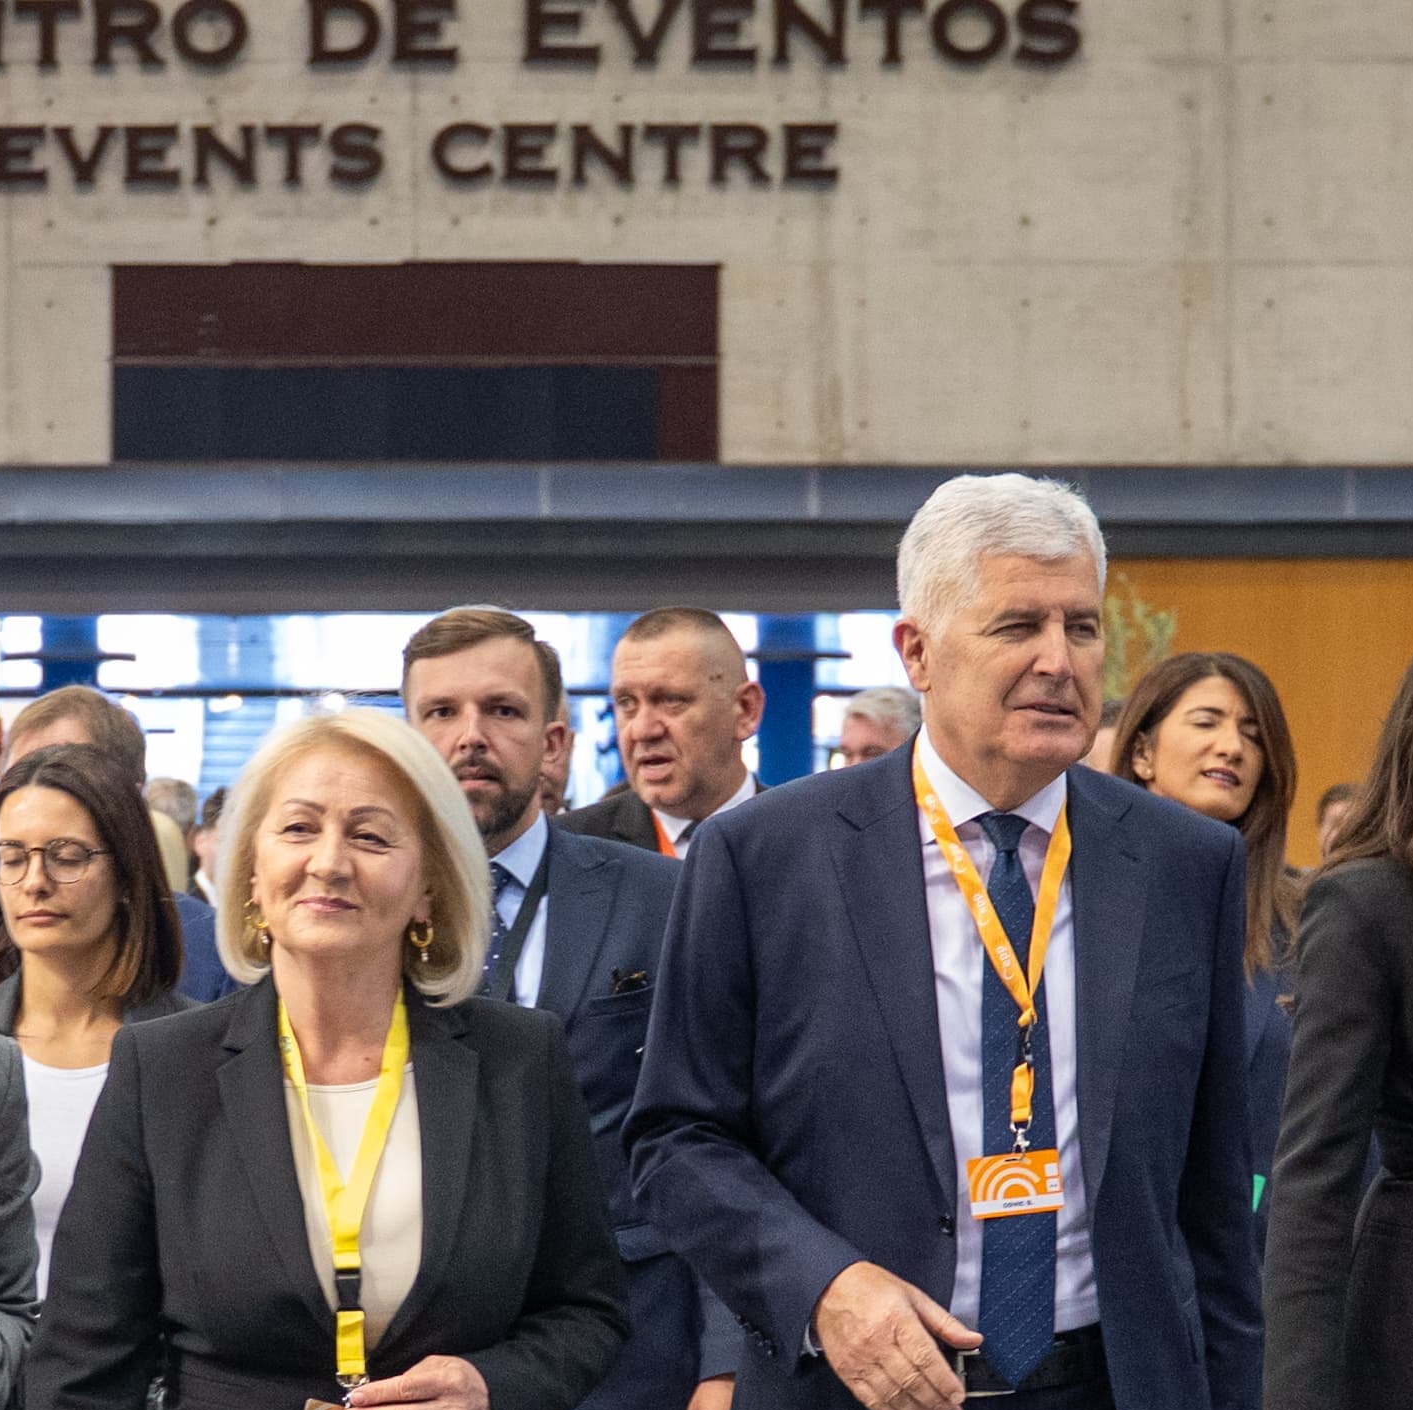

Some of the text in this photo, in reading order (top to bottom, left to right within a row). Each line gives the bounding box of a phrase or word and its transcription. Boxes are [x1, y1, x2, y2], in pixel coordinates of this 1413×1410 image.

[308, 0, 457, 68] DE
[523, 0, 1081, 68] EVENTOS
[431, 121, 840, 185] CENTRE
